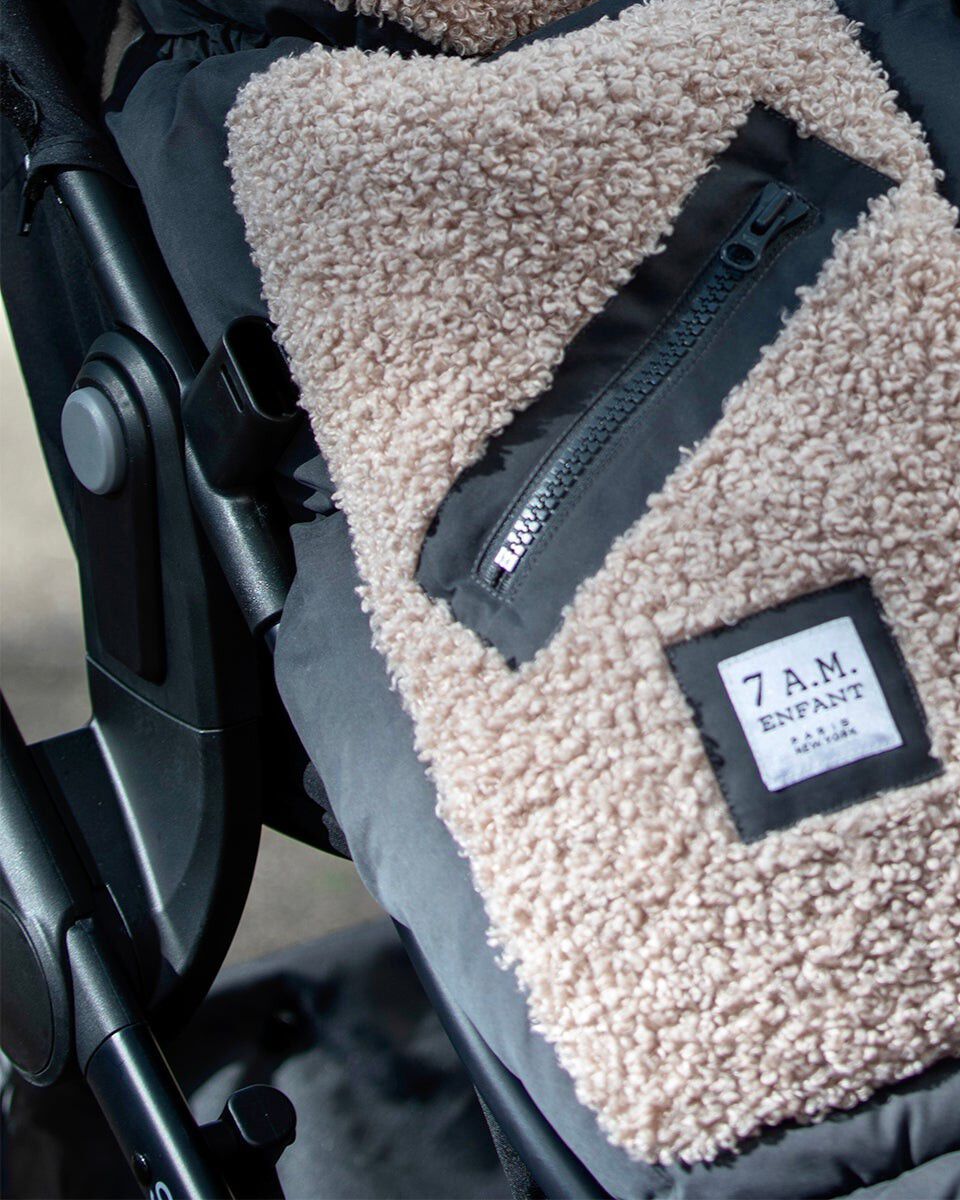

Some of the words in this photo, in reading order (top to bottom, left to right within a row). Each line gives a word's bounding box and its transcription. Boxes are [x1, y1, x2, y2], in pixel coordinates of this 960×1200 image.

[741, 672, 763, 708] 7
[783, 651, 858, 697] A.M.
[758, 682, 864, 733] ENFANT
